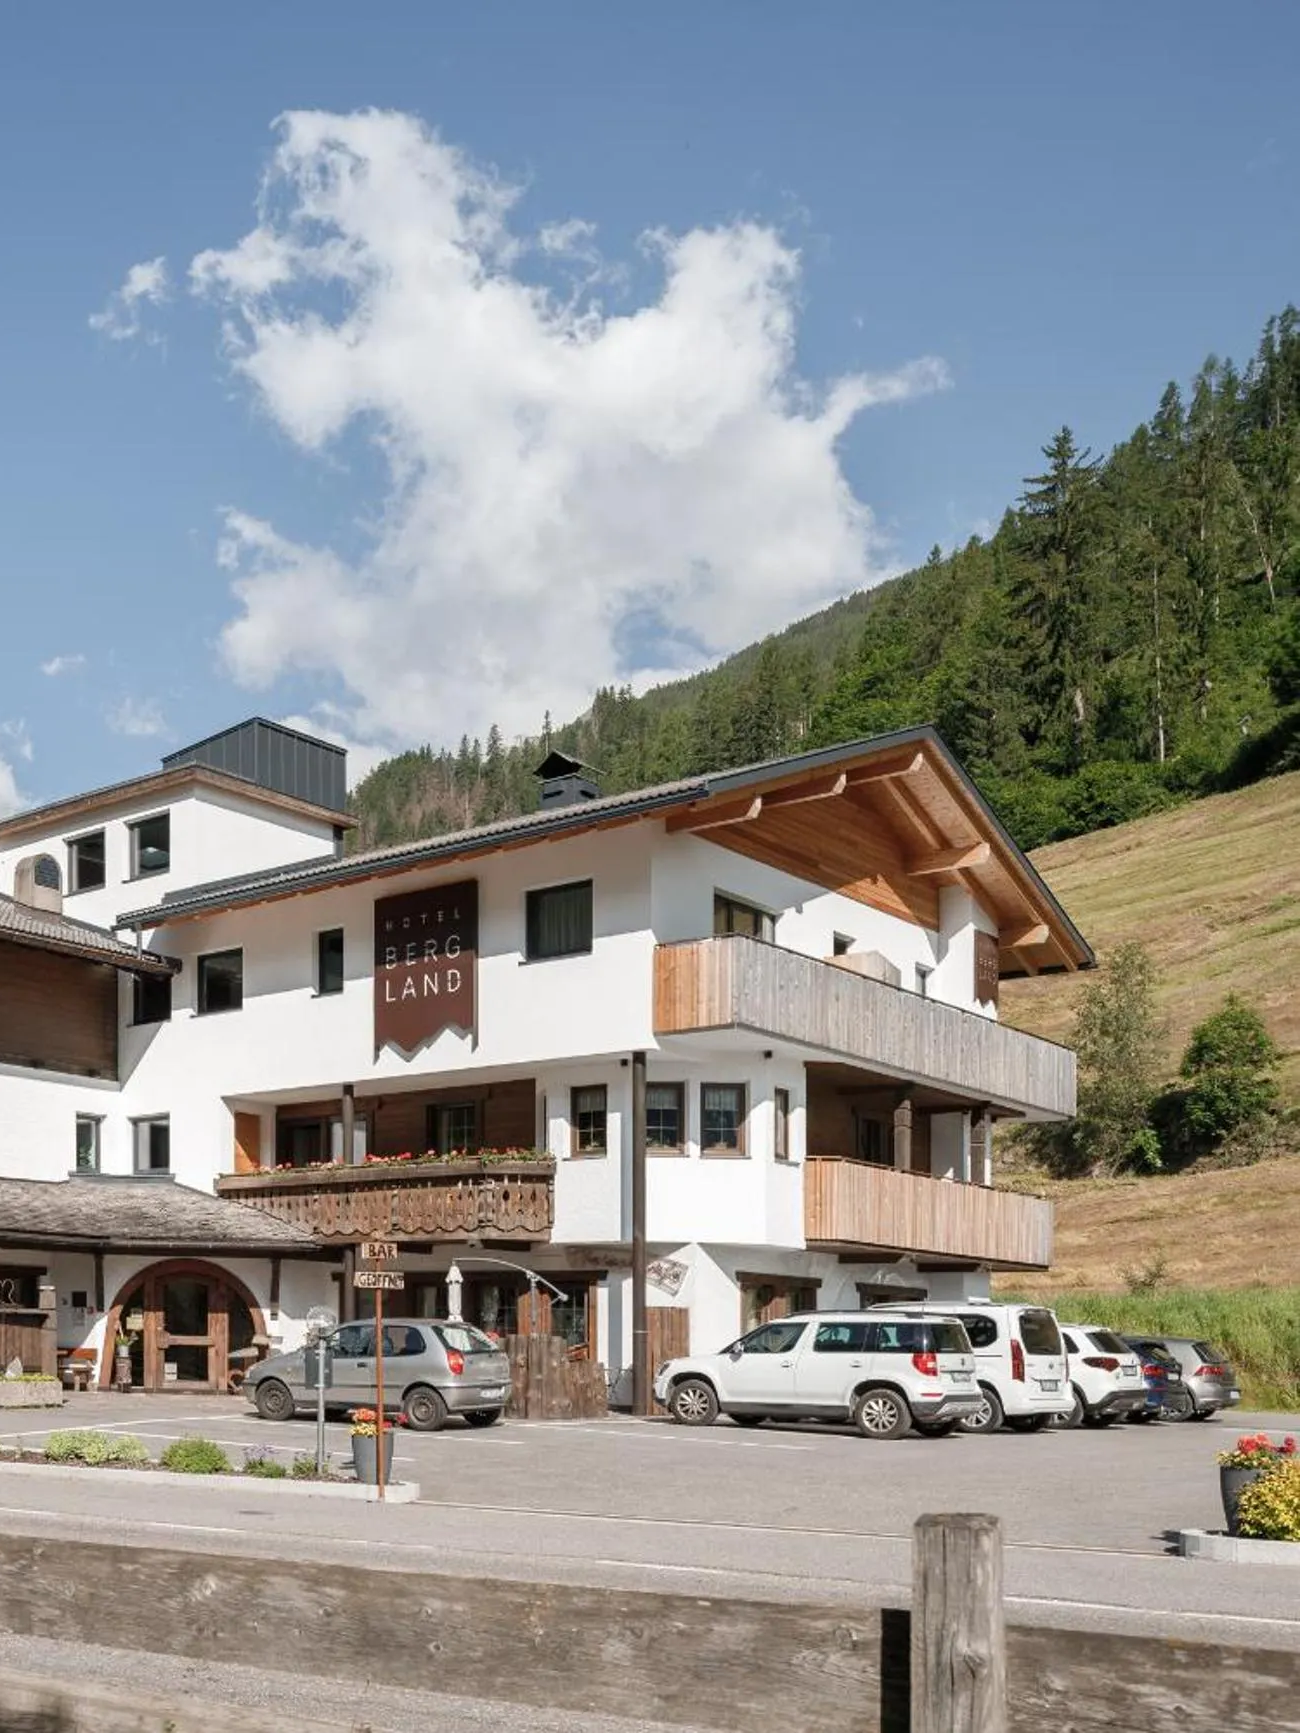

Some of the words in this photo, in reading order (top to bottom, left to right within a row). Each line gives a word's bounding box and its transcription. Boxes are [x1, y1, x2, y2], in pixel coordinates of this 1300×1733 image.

[385, 907, 461, 932] HOTEL
[385, 935, 461, 970] BERG
[385, 969, 462, 1003] LAND
[368, 1243, 395, 1260] BAR
